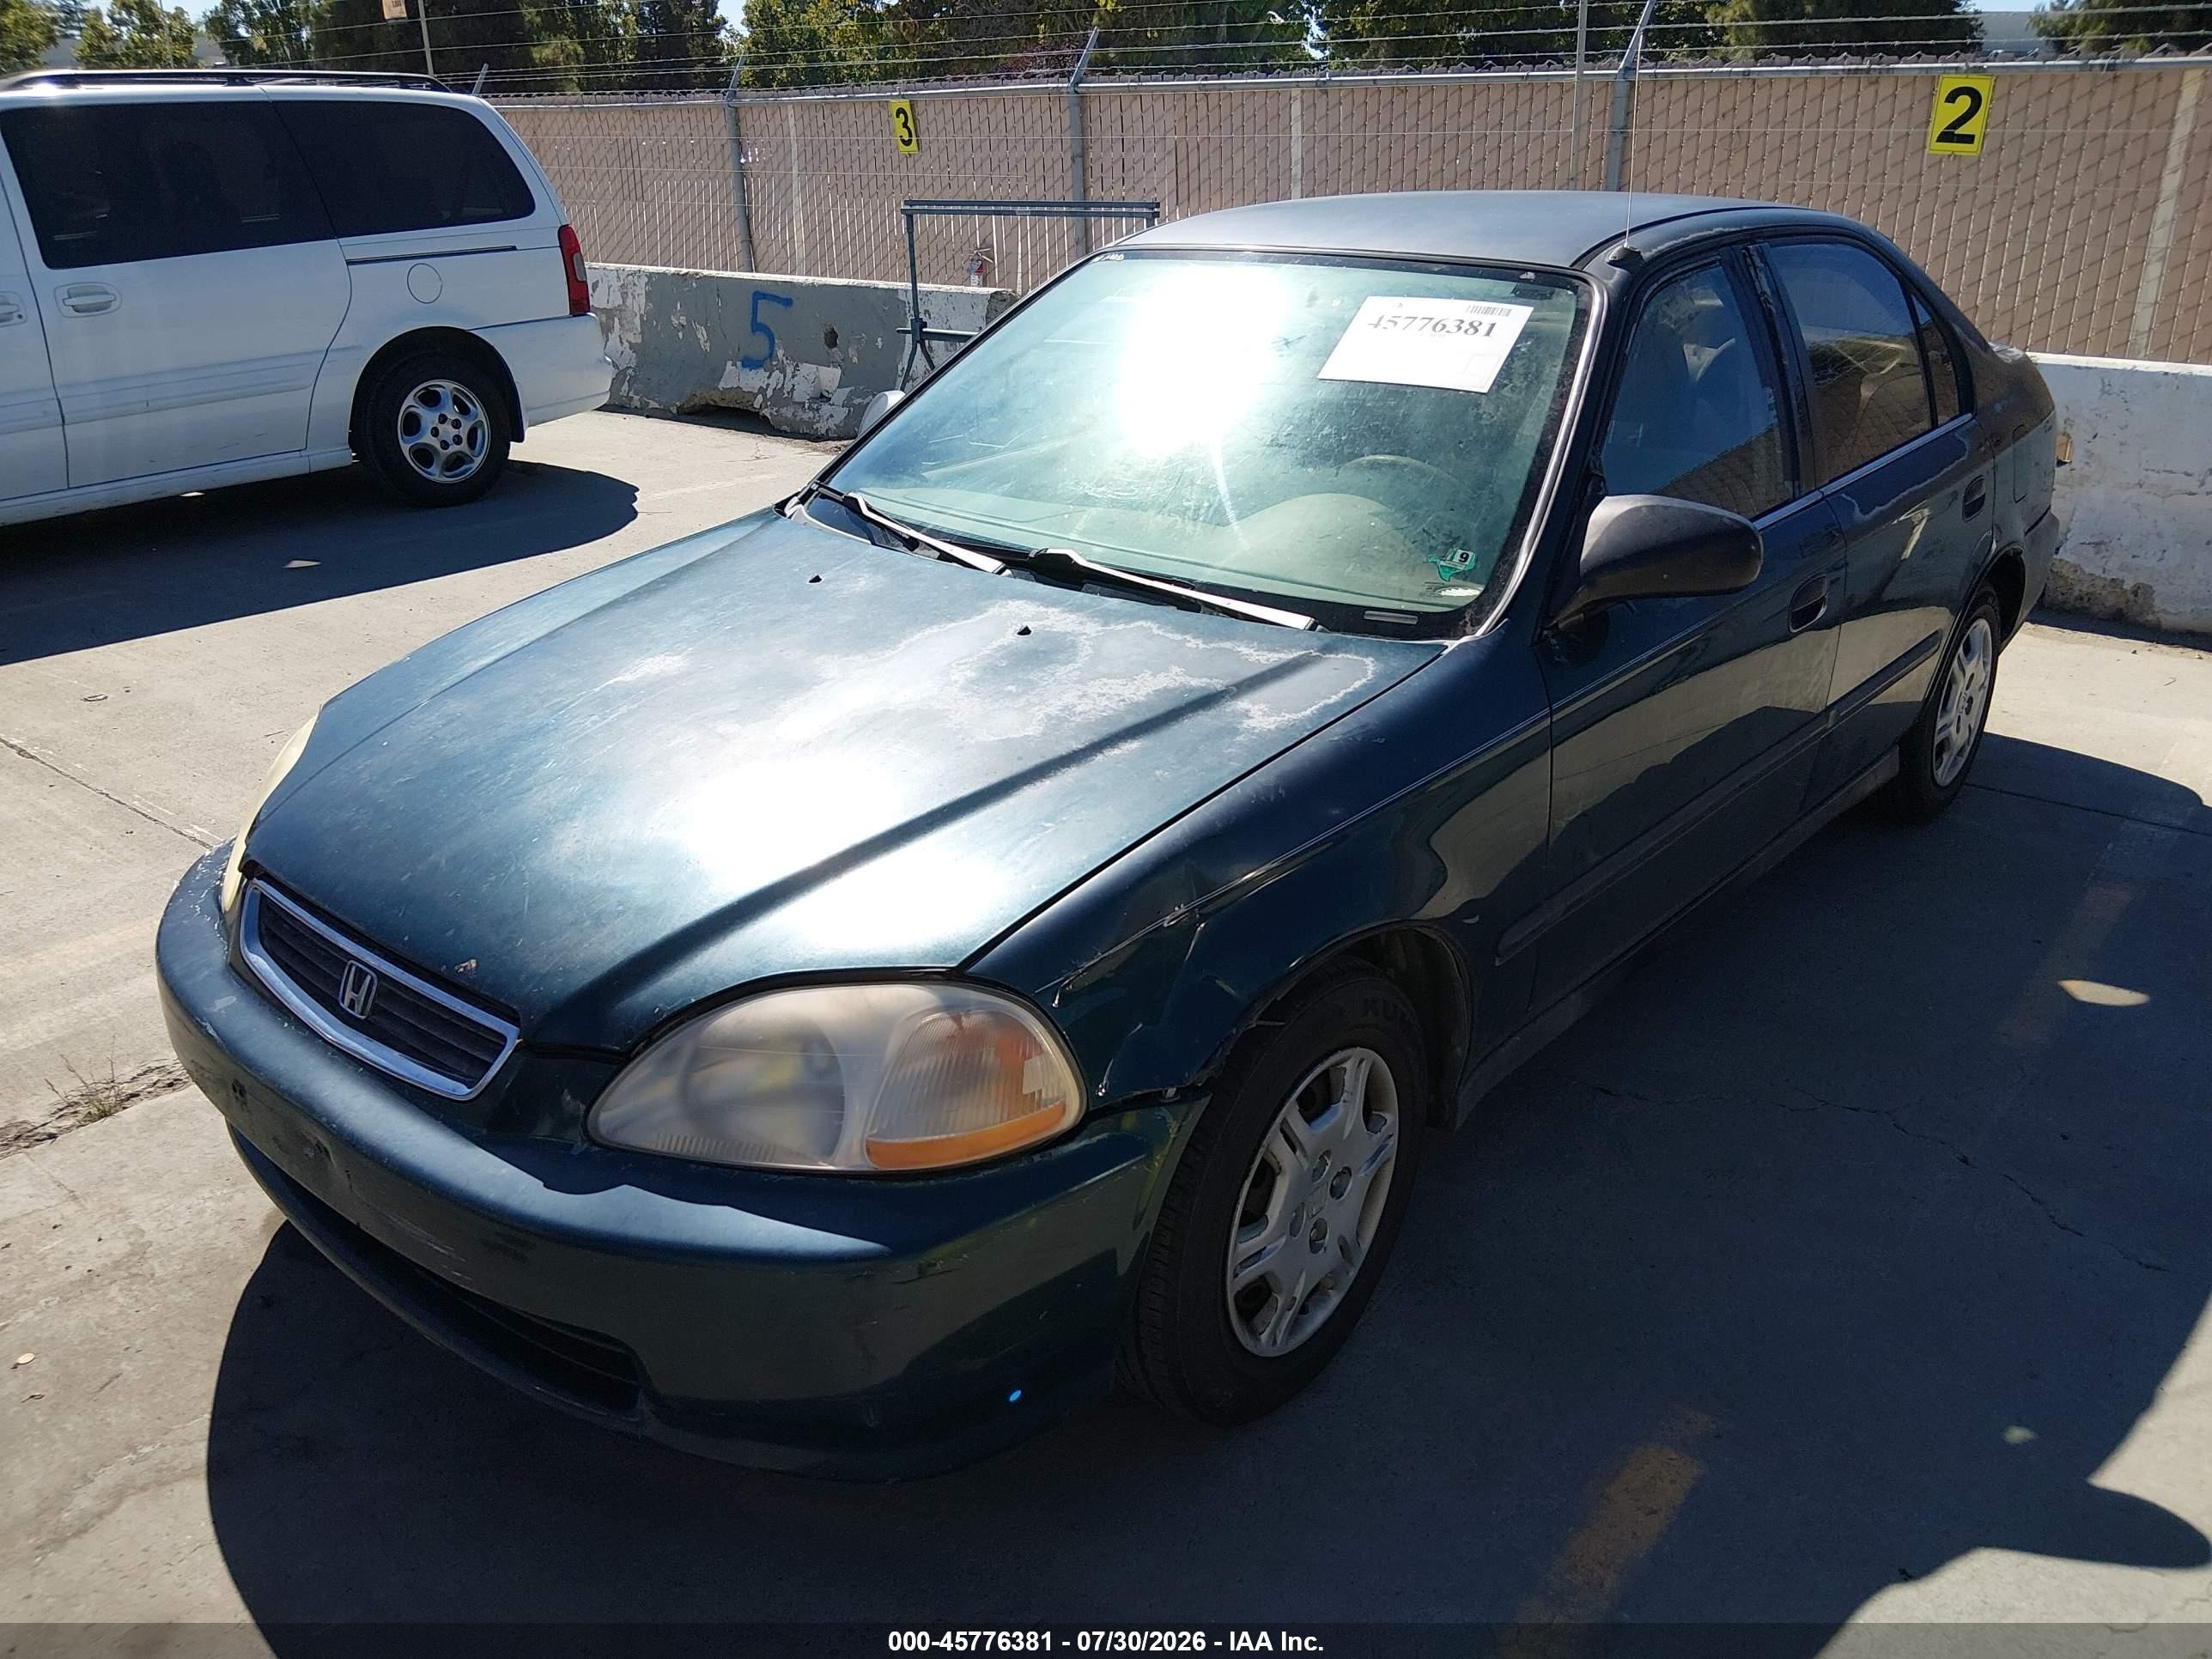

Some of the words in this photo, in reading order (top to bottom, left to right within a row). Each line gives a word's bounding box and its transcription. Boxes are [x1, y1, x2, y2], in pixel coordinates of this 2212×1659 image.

[895, 106, 914, 147] 3
[1936, 86, 1983, 145] 2
[741, 290, 793, 370] 5
[1368, 314, 1498, 338] 45776381
[1458, 551, 1470, 563] 9
